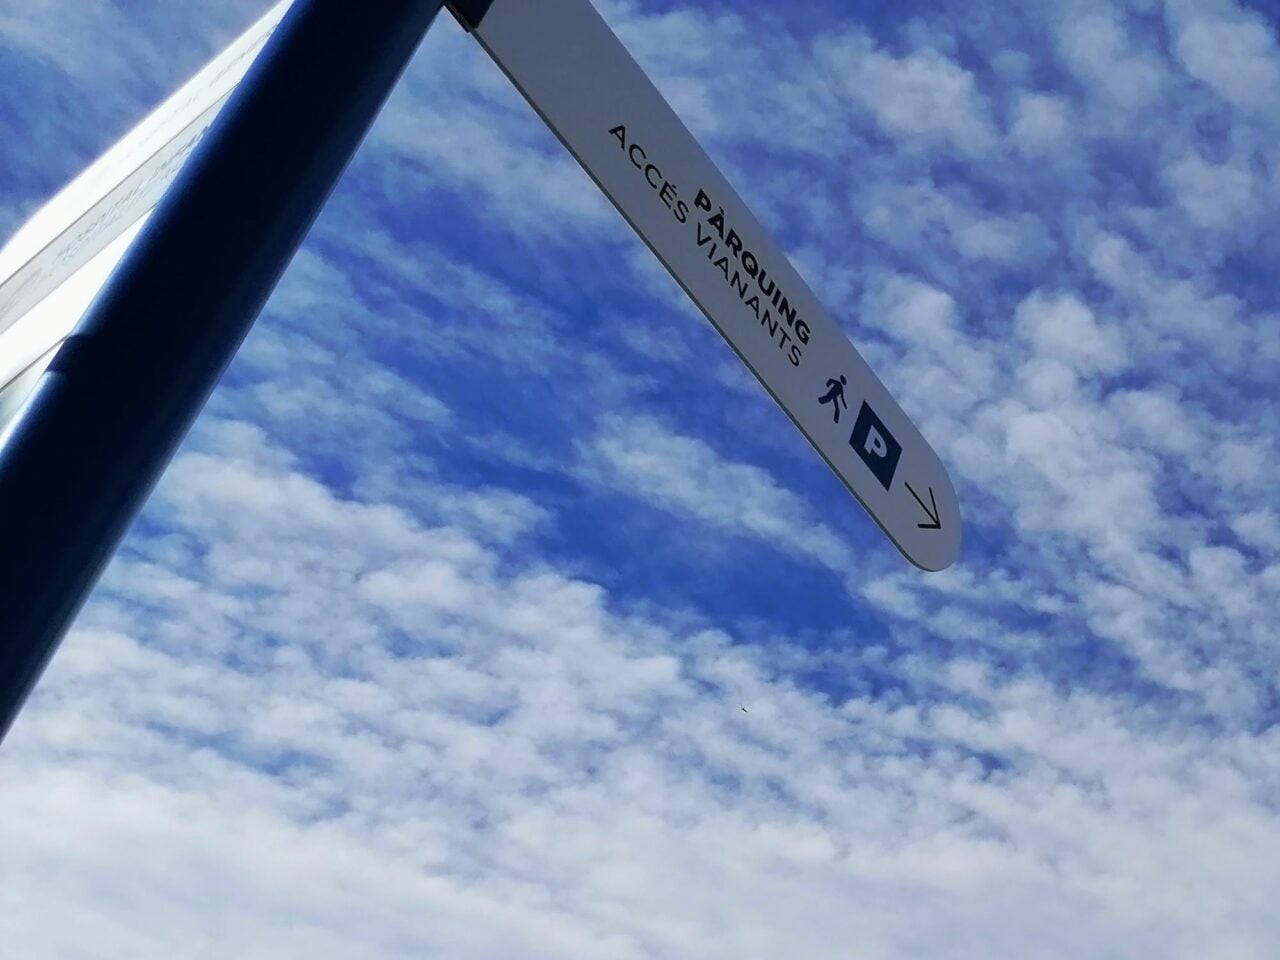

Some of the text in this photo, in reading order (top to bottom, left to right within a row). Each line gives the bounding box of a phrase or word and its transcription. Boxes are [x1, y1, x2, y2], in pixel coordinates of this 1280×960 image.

[608, 124, 802, 367] ACCÉS VIANANTS
[694, 187, 811, 346] PÀRQUING
[863, 424, 888, 459] P
